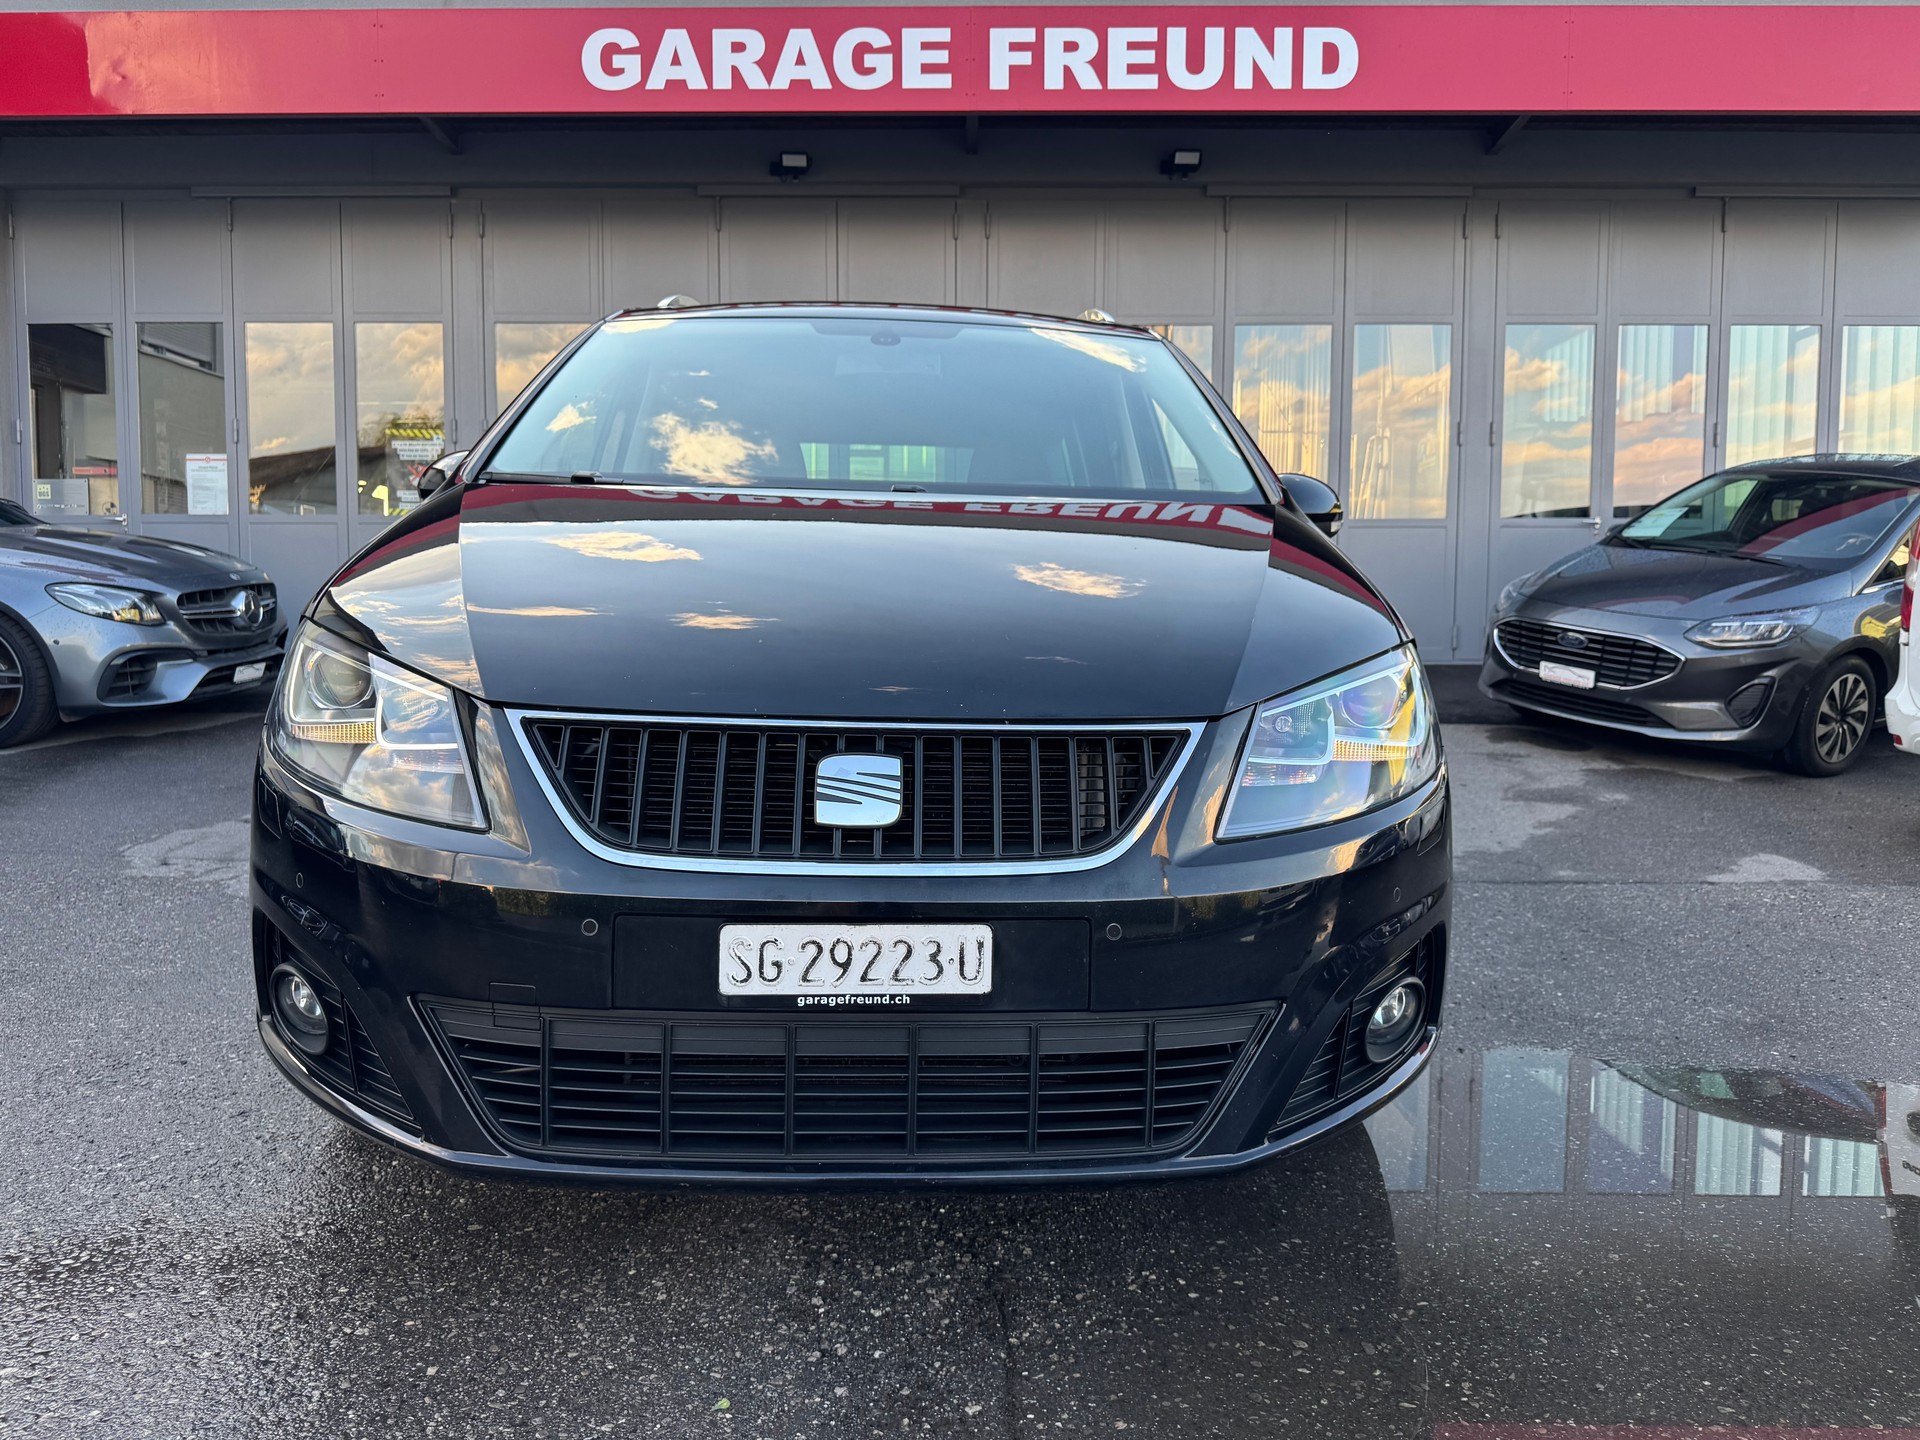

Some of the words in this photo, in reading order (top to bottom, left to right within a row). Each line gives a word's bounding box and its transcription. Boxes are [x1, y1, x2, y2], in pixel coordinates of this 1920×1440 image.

[581, 27, 953, 91] GARAGE
[988, 26, 1360, 91] FREUND
[797, 994, 911, 1007] garagefreund.ch
